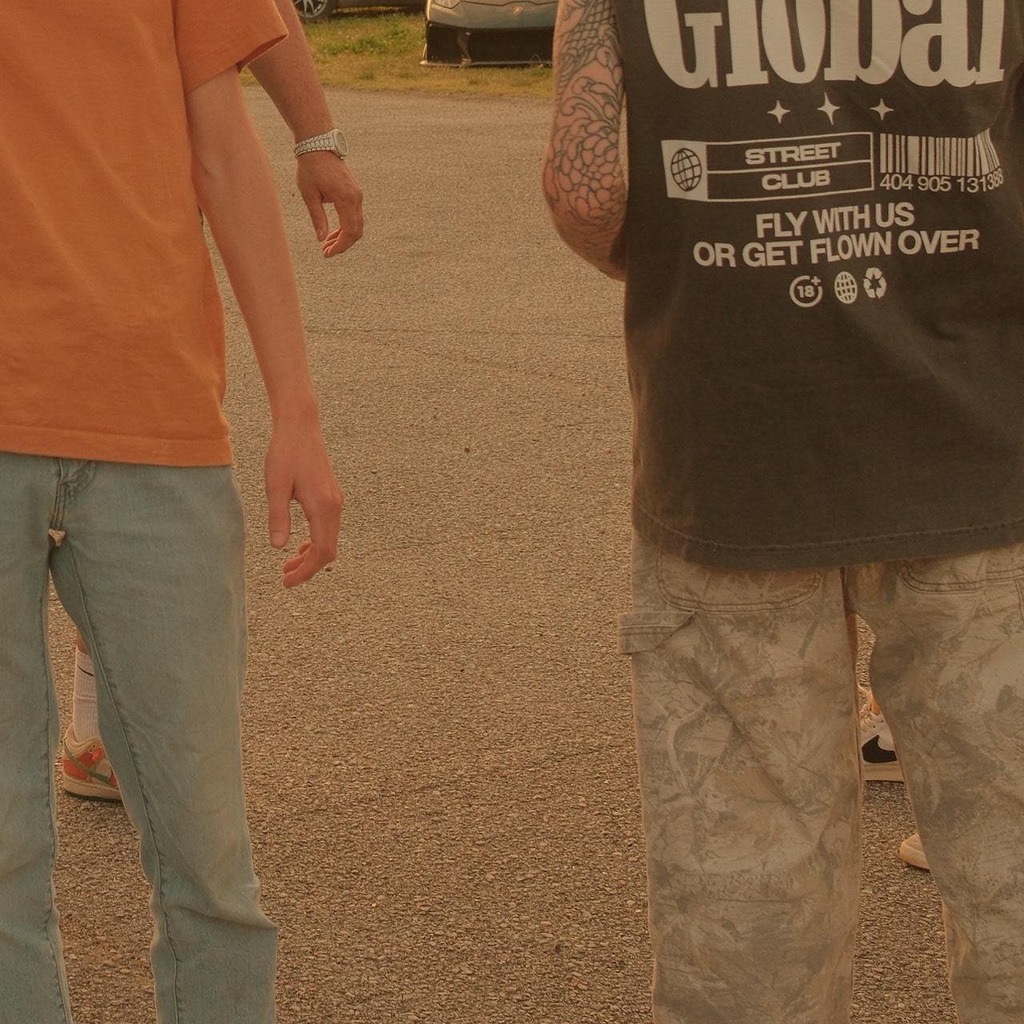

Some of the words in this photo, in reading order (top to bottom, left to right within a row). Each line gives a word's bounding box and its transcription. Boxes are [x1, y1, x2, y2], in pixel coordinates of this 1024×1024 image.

[744, 141, 842, 166] STREET
[761, 169, 831, 193] CLUB
[879, 174, 914, 190] 404
[917, 176, 952, 192] 905
[755, 211, 808, 239] FLY
[811, 204, 870, 235] WITH
[875, 201, 915, 228] US
[693, 242, 736, 268] OR
[742, 240, 803, 267] GET
[810, 232, 891, 264] FLOWN
[897, 229, 980, 256] OVER
